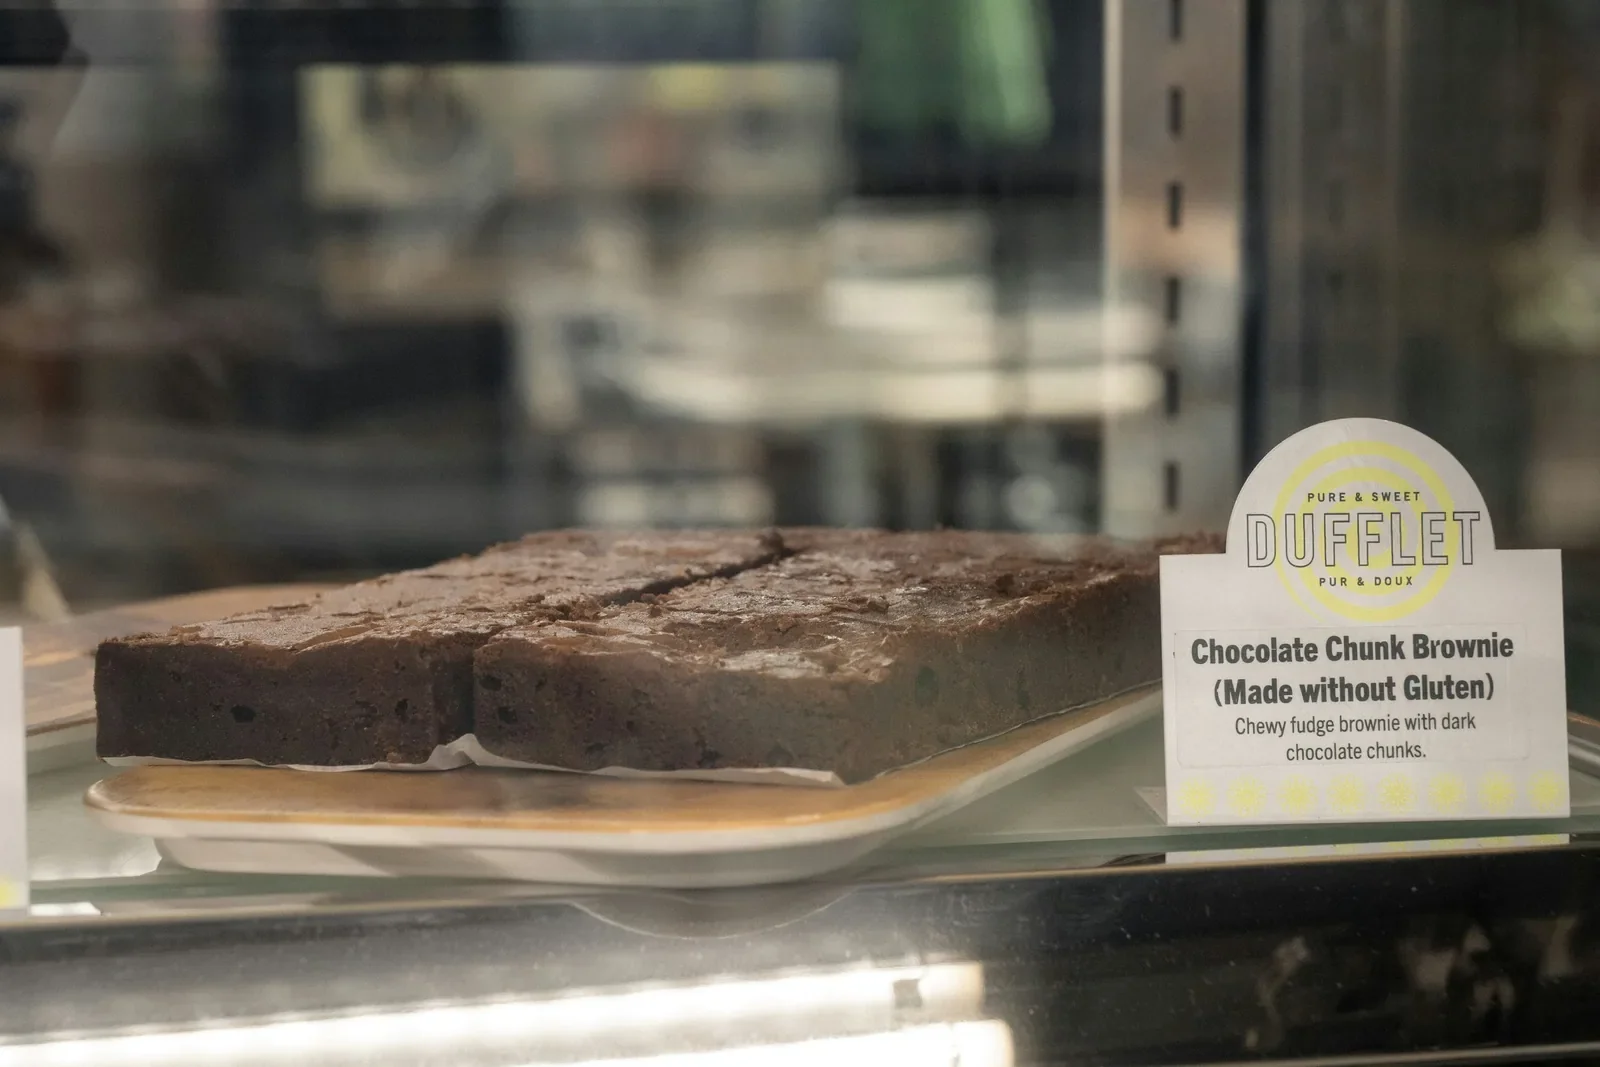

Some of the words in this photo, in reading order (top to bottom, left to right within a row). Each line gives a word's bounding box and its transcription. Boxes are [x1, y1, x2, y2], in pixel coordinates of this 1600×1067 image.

[1307, 492, 1346, 502] PURE
[1355, 492, 1362, 501] &
[1372, 492, 1420, 501] SWEET
[1247, 511, 1480, 567] DUFFLET
[1319, 577, 1347, 586] PUR
[1357, 577, 1364, 586] &
[1374, 576, 1412, 586] DOUX
[1191, 637, 1318, 664] Chocolate
[1326, 634, 1405, 660] Chunk
[1412, 632, 1513, 659] Brownie
[1214, 678, 1293, 706] (Made
[1299, 676, 1396, 702] without
[1403, 673, 1494, 701] Gluten)
[1235, 717, 1286, 737] Chewy
[1290, 717, 1334, 736] fudge
[1339, 715, 1400, 732] brownie
[1404, 714, 1437, 730] with
[1441, 712, 1476, 729] dark
[1286, 743, 1362, 761] chocolate
[1367, 741, 1426, 759] chunks.
